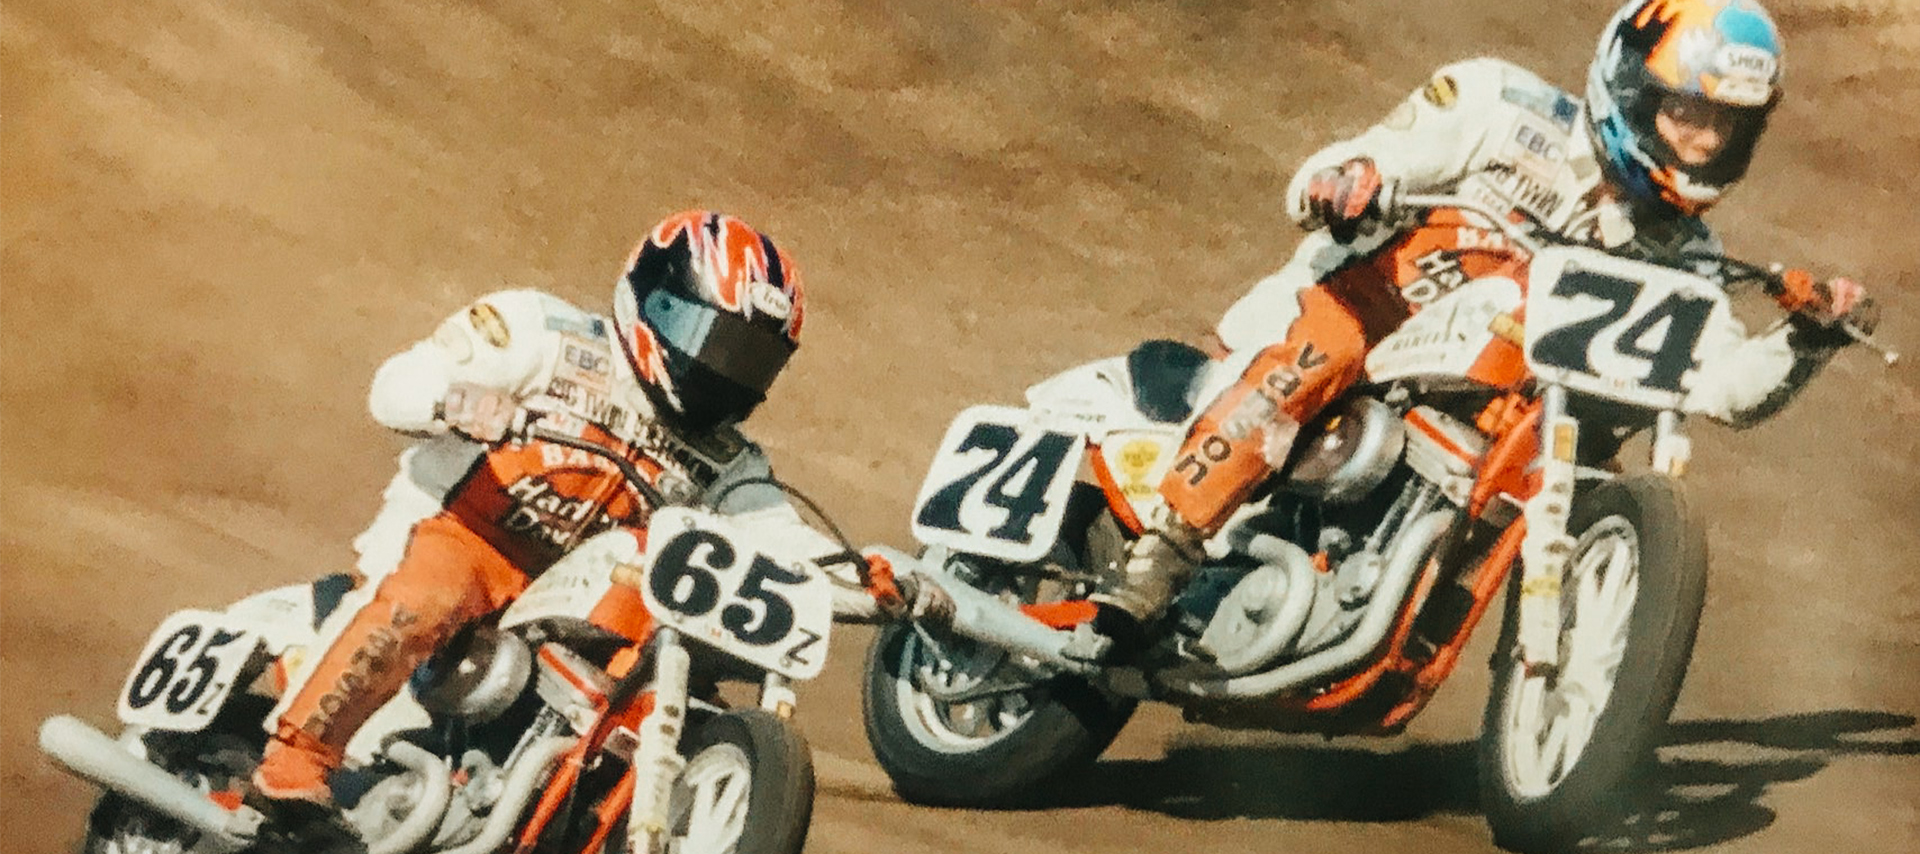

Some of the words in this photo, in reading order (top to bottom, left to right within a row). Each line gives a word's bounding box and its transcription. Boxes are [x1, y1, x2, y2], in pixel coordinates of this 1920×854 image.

[1514, 124, 1565, 162] EBC
[563, 343, 611, 377] EBC
[1531, 270, 1717, 396] 74
[916, 422, 1079, 545] 74
